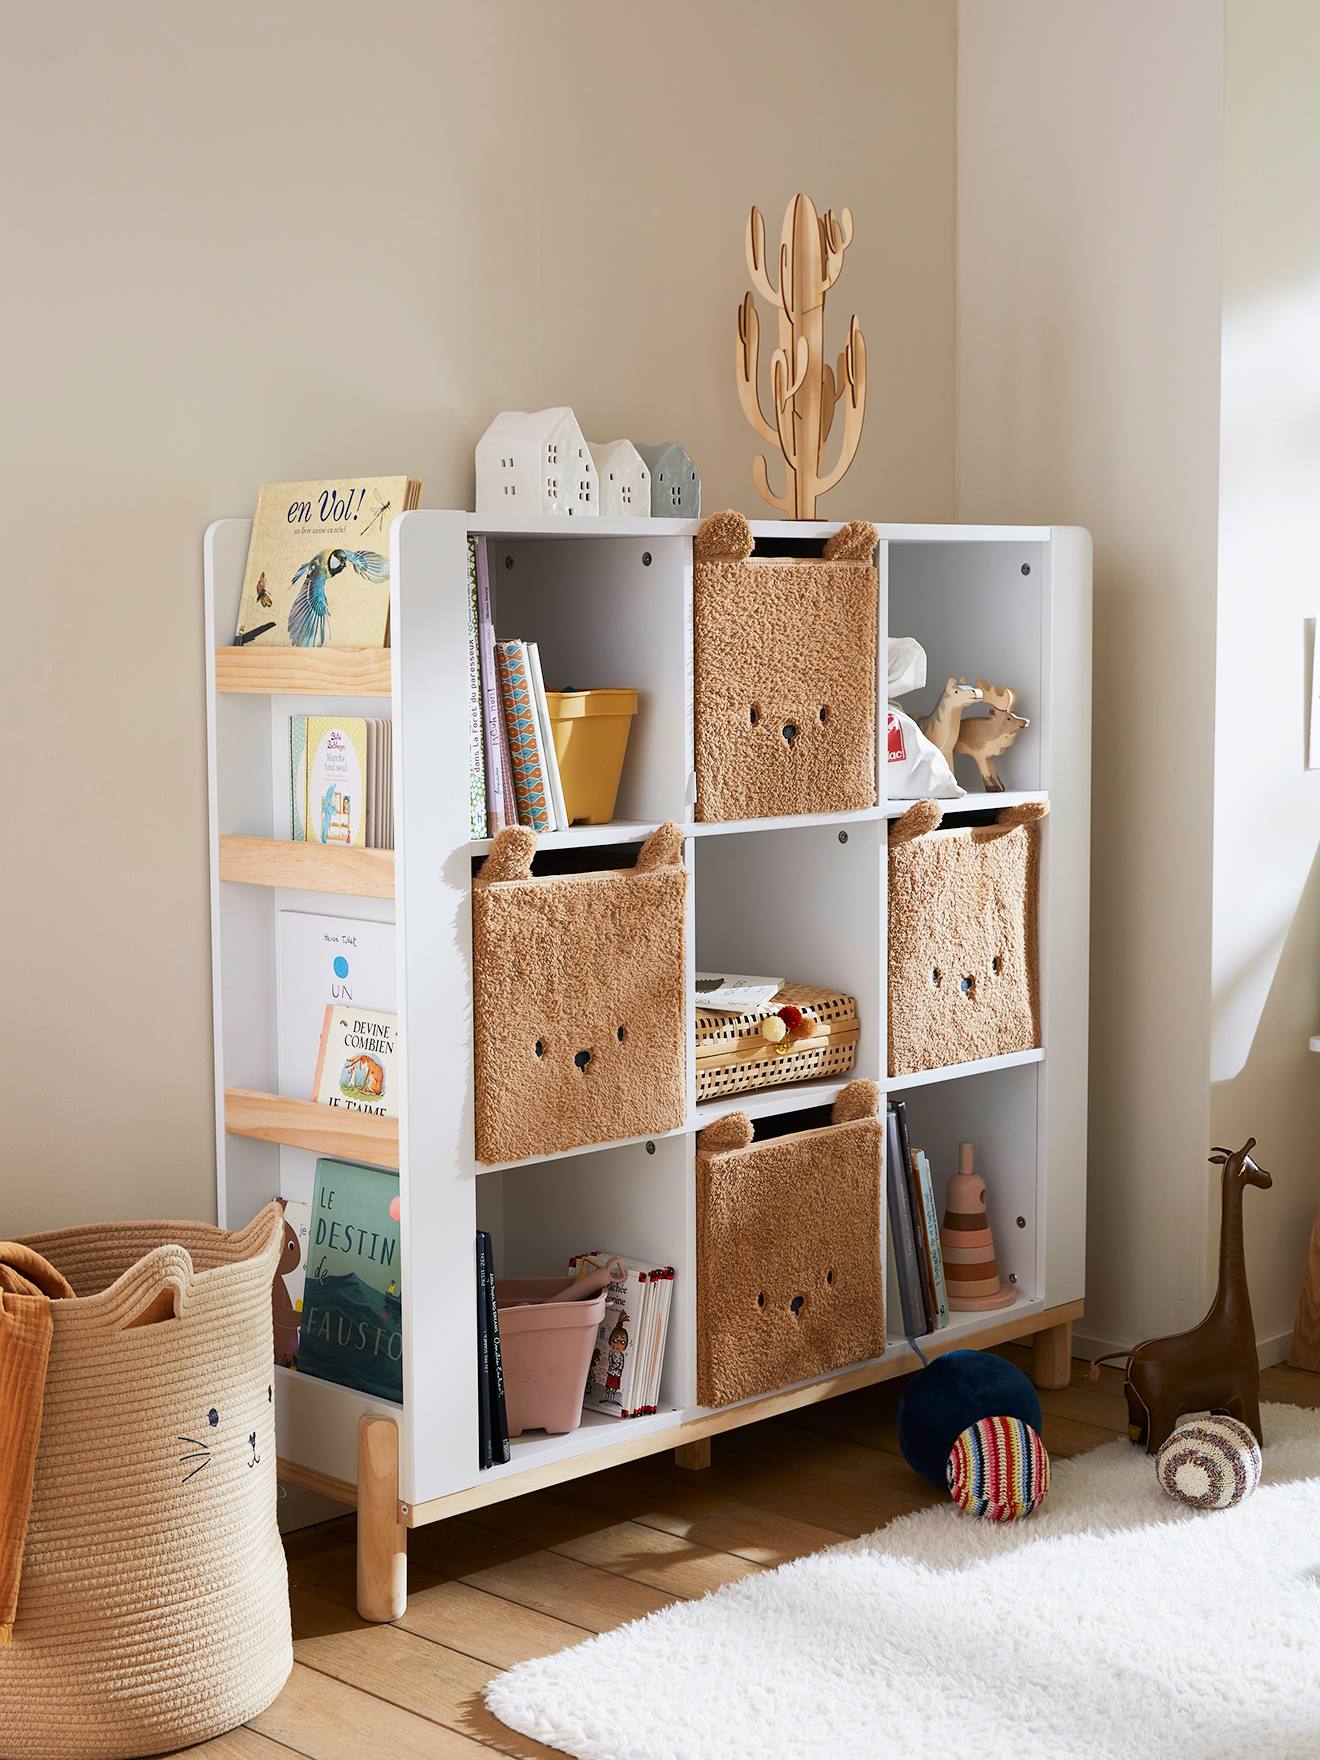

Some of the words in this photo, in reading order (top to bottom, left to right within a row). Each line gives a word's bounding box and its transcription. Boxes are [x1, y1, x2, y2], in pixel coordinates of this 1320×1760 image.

[287, 500, 312, 523] en
[318, 488, 366, 522] Vol!
[469, 639, 477, 689] paresseux
[470, 691, 477, 703] du
[473, 737, 480, 748] la
[331, 983, 353, 1000] UN
[353, 1020, 390, 1039] DEVINE
[344, 1034, 395, 1054] COMBIEN
[320, 1186, 336, 1210] LE
[315, 1217, 396, 1267] DESTIN
[314, 1255, 328, 1284] de
[306, 1306, 402, 1361] FAUSTO
